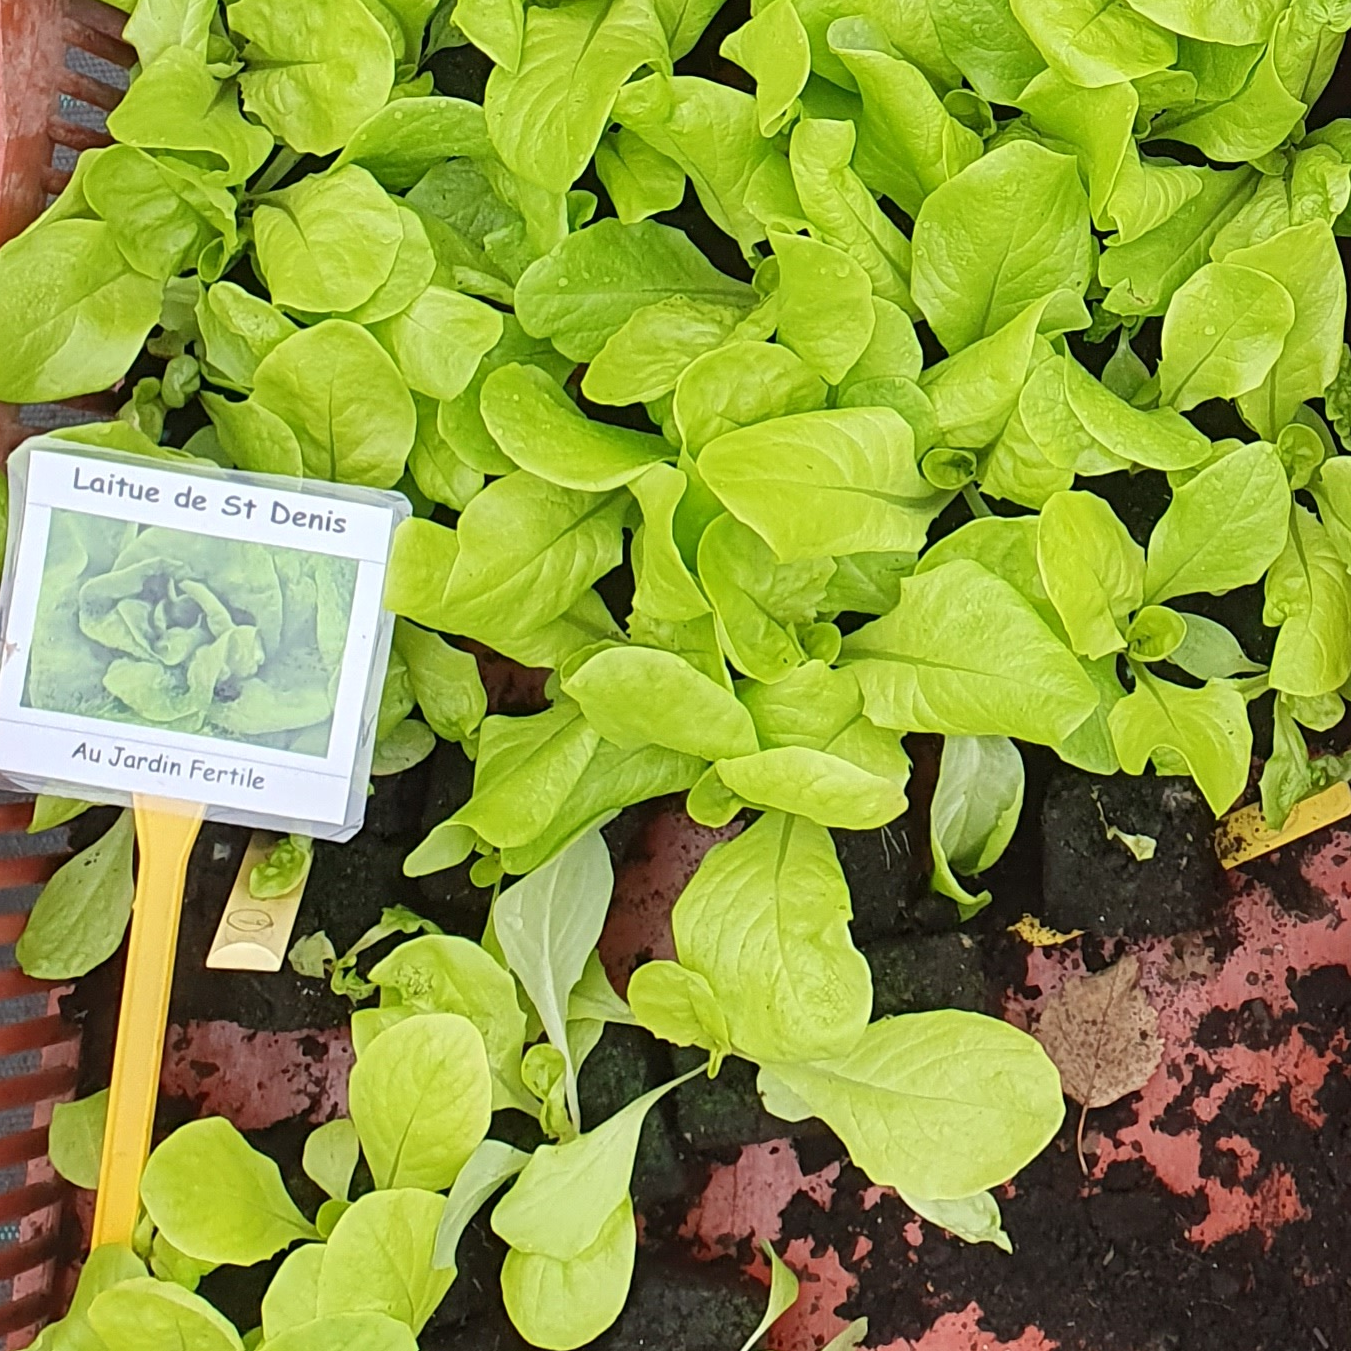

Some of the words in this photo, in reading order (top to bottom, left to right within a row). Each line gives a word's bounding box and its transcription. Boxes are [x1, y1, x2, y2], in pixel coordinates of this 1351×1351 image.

[73, 467, 160, 503] Laitue
[174, 486, 208, 512] de
[221, 495, 257, 519] St
[270, 501, 347, 534] Denis
[72, 742, 102, 763] Au
[108, 747, 182, 777] Jardin
[189, 760, 266, 790] Fertile
